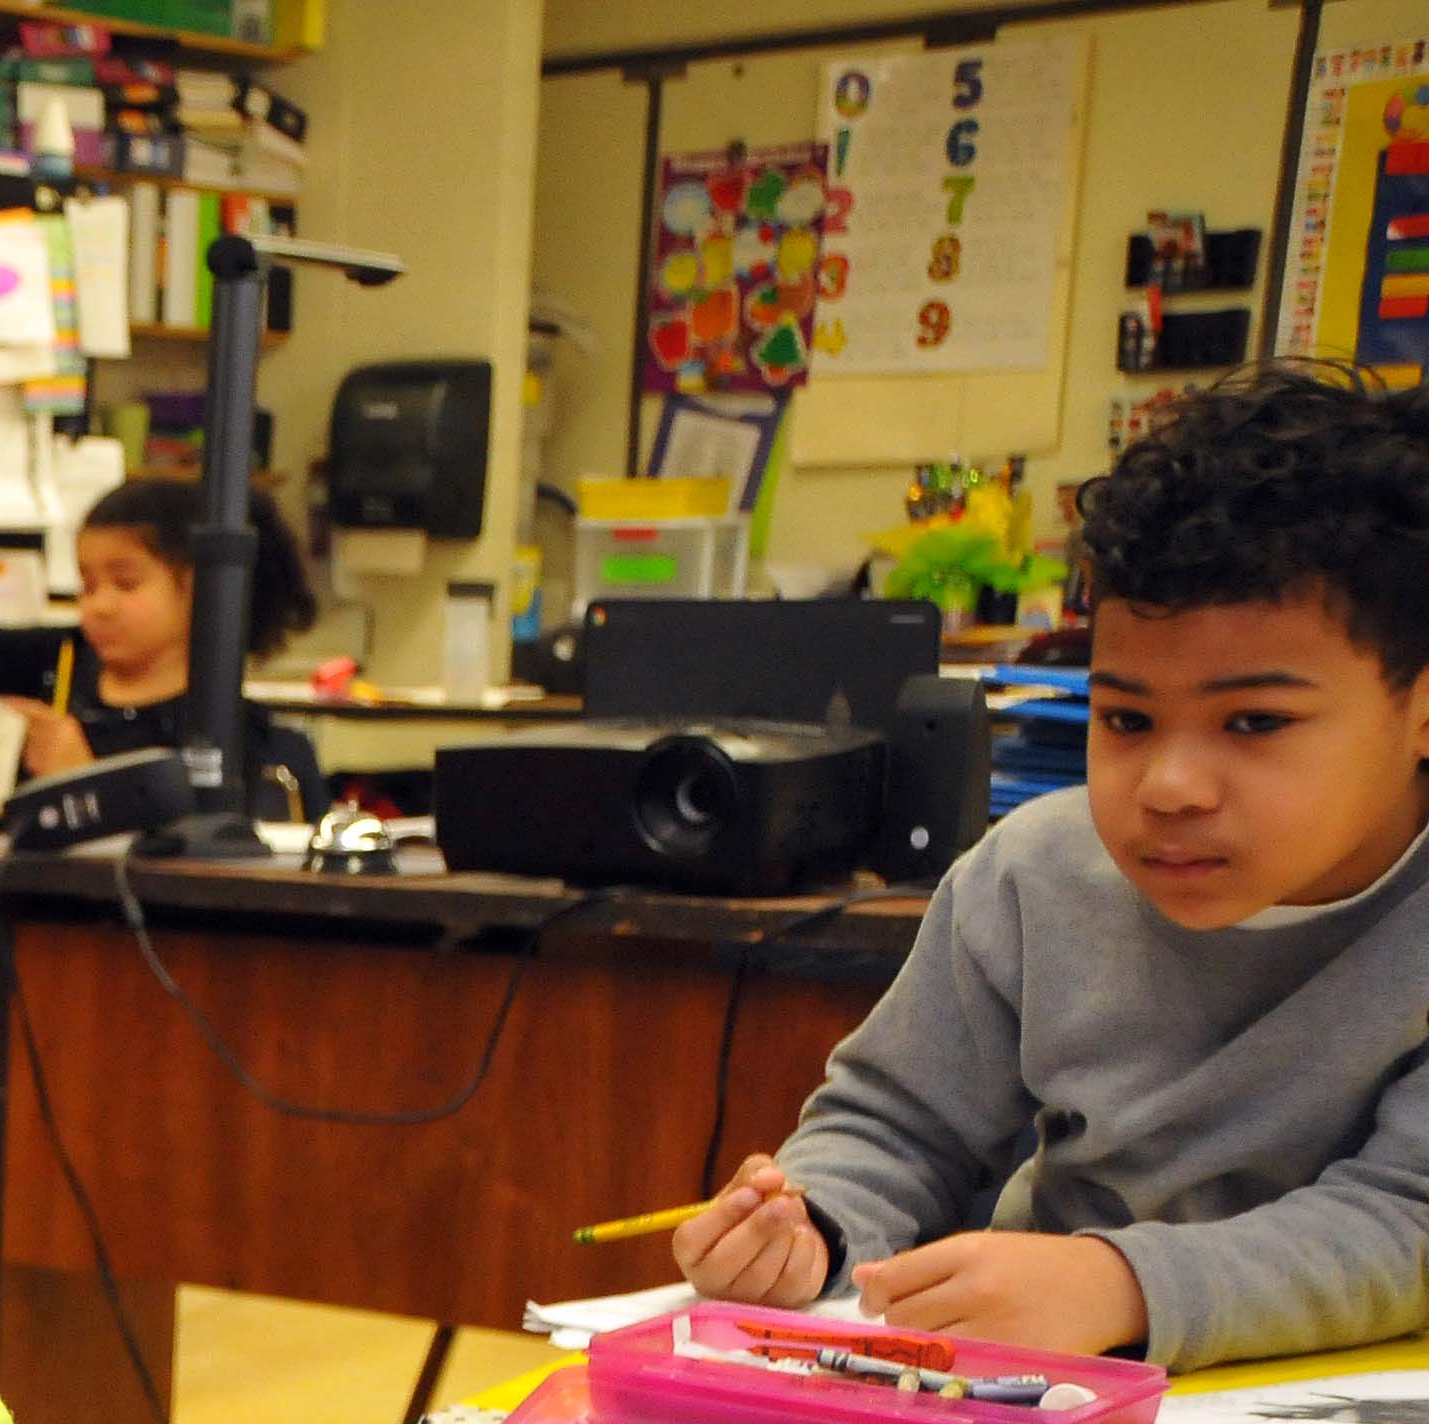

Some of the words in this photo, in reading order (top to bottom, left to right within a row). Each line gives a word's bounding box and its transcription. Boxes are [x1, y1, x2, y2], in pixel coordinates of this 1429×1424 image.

[834, 70, 871, 118] 0
[953, 60, 984, 109] 5
[946, 118, 979, 166] 6
[825, 187, 854, 234] 2
[941, 176, 977, 226] 7
[818, 254, 850, 300] 3
[928, 234, 962, 285] 8
[816, 319, 847, 356] 4
[916, 299, 951, 349] 9
